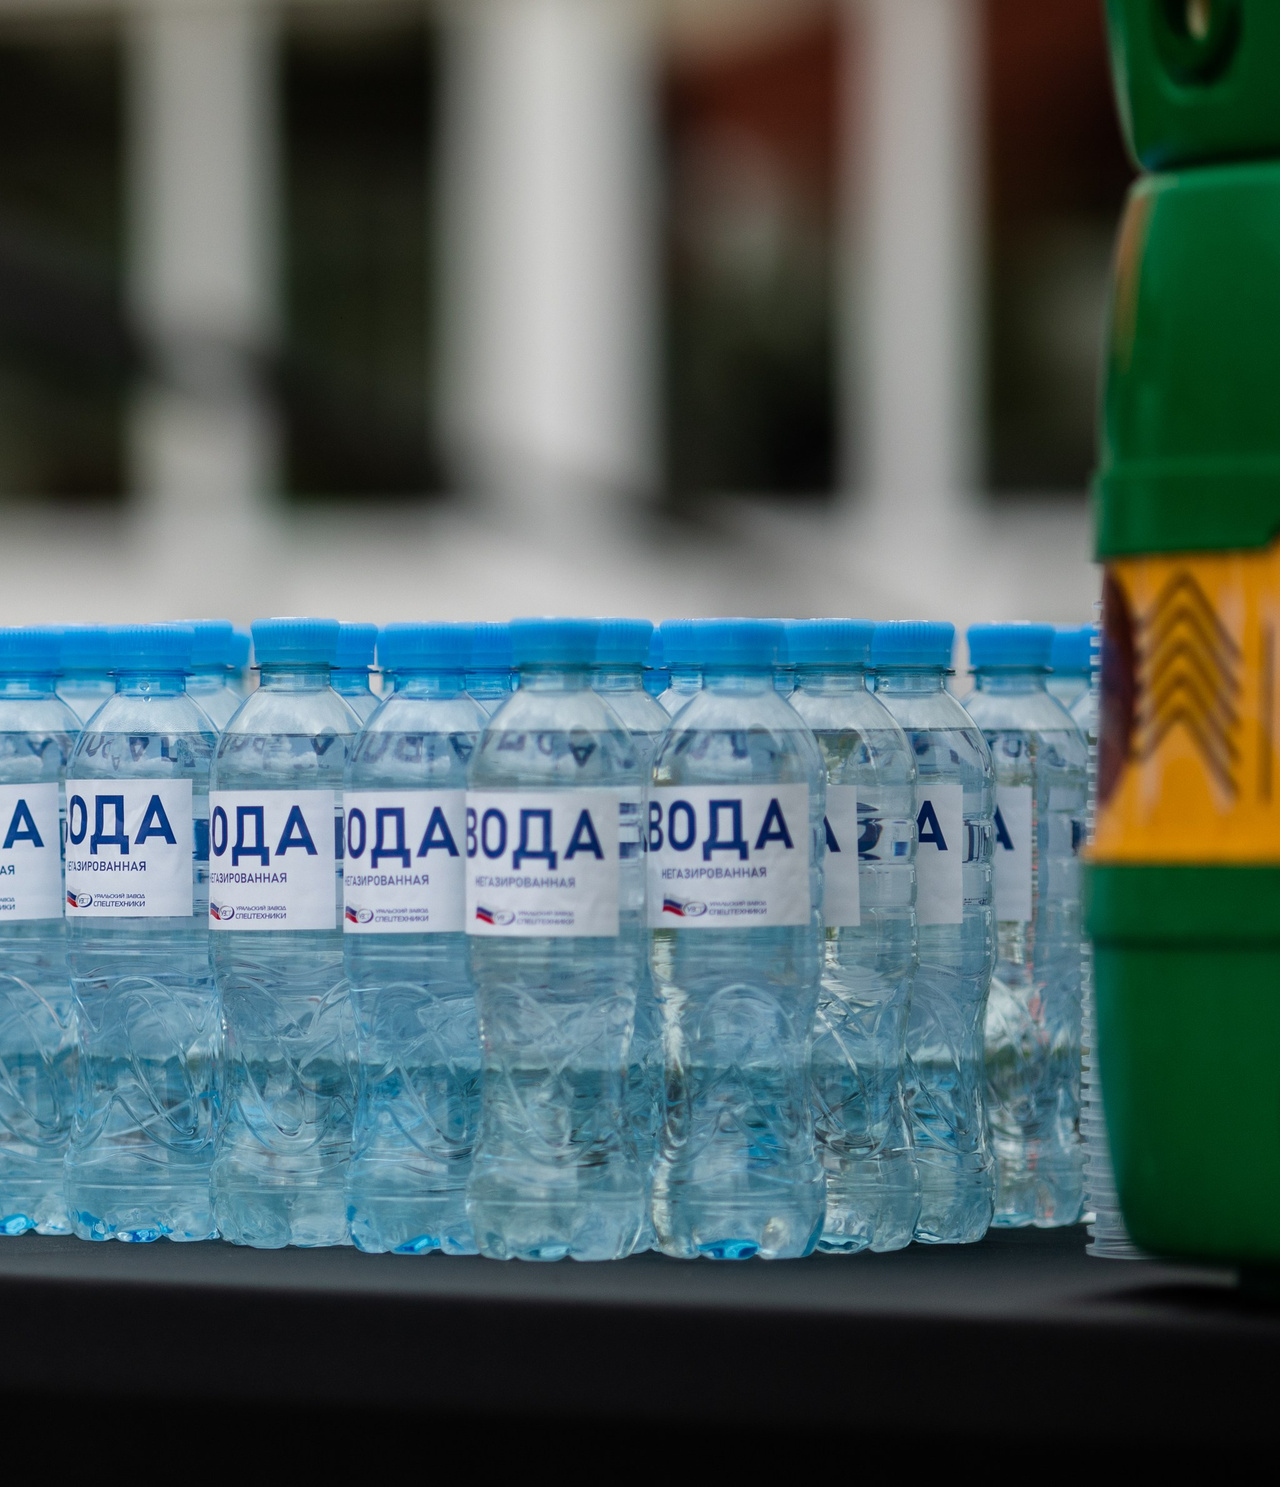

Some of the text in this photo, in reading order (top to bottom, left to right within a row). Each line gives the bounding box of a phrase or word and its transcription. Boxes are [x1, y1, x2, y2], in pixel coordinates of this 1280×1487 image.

[65, 794, 178, 856] ОДА
[648, 798, 795, 861] ВОДА
[209, 804, 319, 867] ОДА
[343, 805, 460, 869] ОДА
[466, 807, 605, 871] ВОДА
[67, 860, 147, 872] ЕГАЗИРОВАННАЯ
[661, 866, 768, 880] НЕГАЗИРОВАННАЯ
[475, 875, 576, 889] НЕГАЗИРОВАННАЯ
[93, 900, 146, 908] СПЕЦТЕХНИКИ
[235, 912, 287, 920] СПЕЦТЕХНИКИ
[708, 907, 768, 916] СПЕЦТЕХНИКИ
[375, 915, 430, 923] СПЕЦТЕХНИКИ
